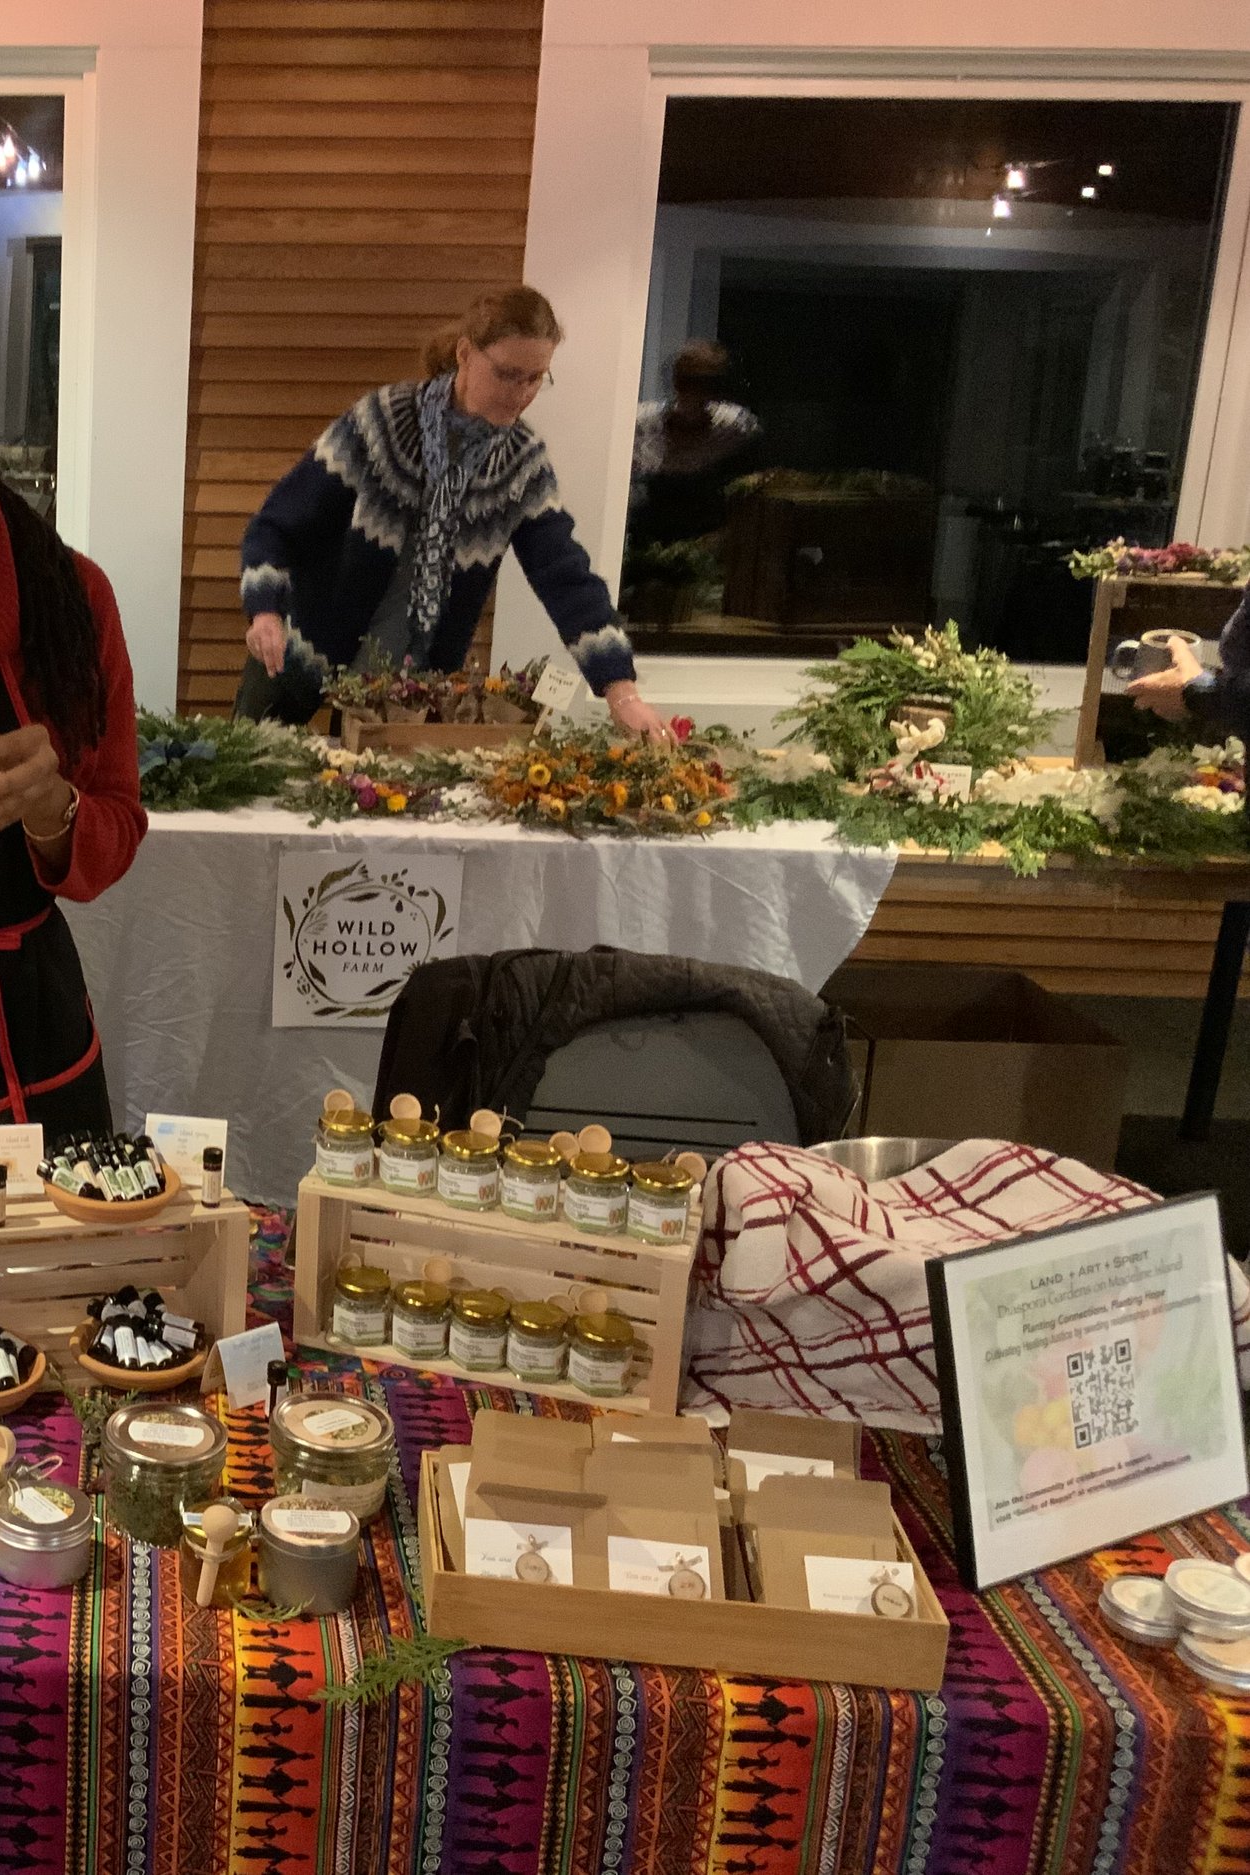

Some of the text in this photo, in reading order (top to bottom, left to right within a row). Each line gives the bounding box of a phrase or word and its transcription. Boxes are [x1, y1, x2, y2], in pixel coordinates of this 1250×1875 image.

[337, 920, 395, 936] WILD
[313, 940, 418, 957] HOLLOW
[342, 961, 384, 973] FARM
[1030, 1273, 1064, 1290] LAND
[1078, 1262, 1101, 1277] ART
[1113, 1250, 1148, 1269] SPIRIT
[997, 1253, 1183, 1320] Diaspora Gardens on Madeline Island
[1022, 1319, 1056, 1334] Planting
[1111, 1295, 1143, 1310] Planting
[1144, 1289, 1166, 1300] Hope
[985, 1345, 1022, 1363] Cultivating
[1022, 1337, 1049, 1351] Healing
[1050, 1331, 1073, 1344] Justice
[995, 1500, 1010, 1510] Join
[1011, 1495, 1024, 1504] the
[1025, 1482, 1064, 1500] community
